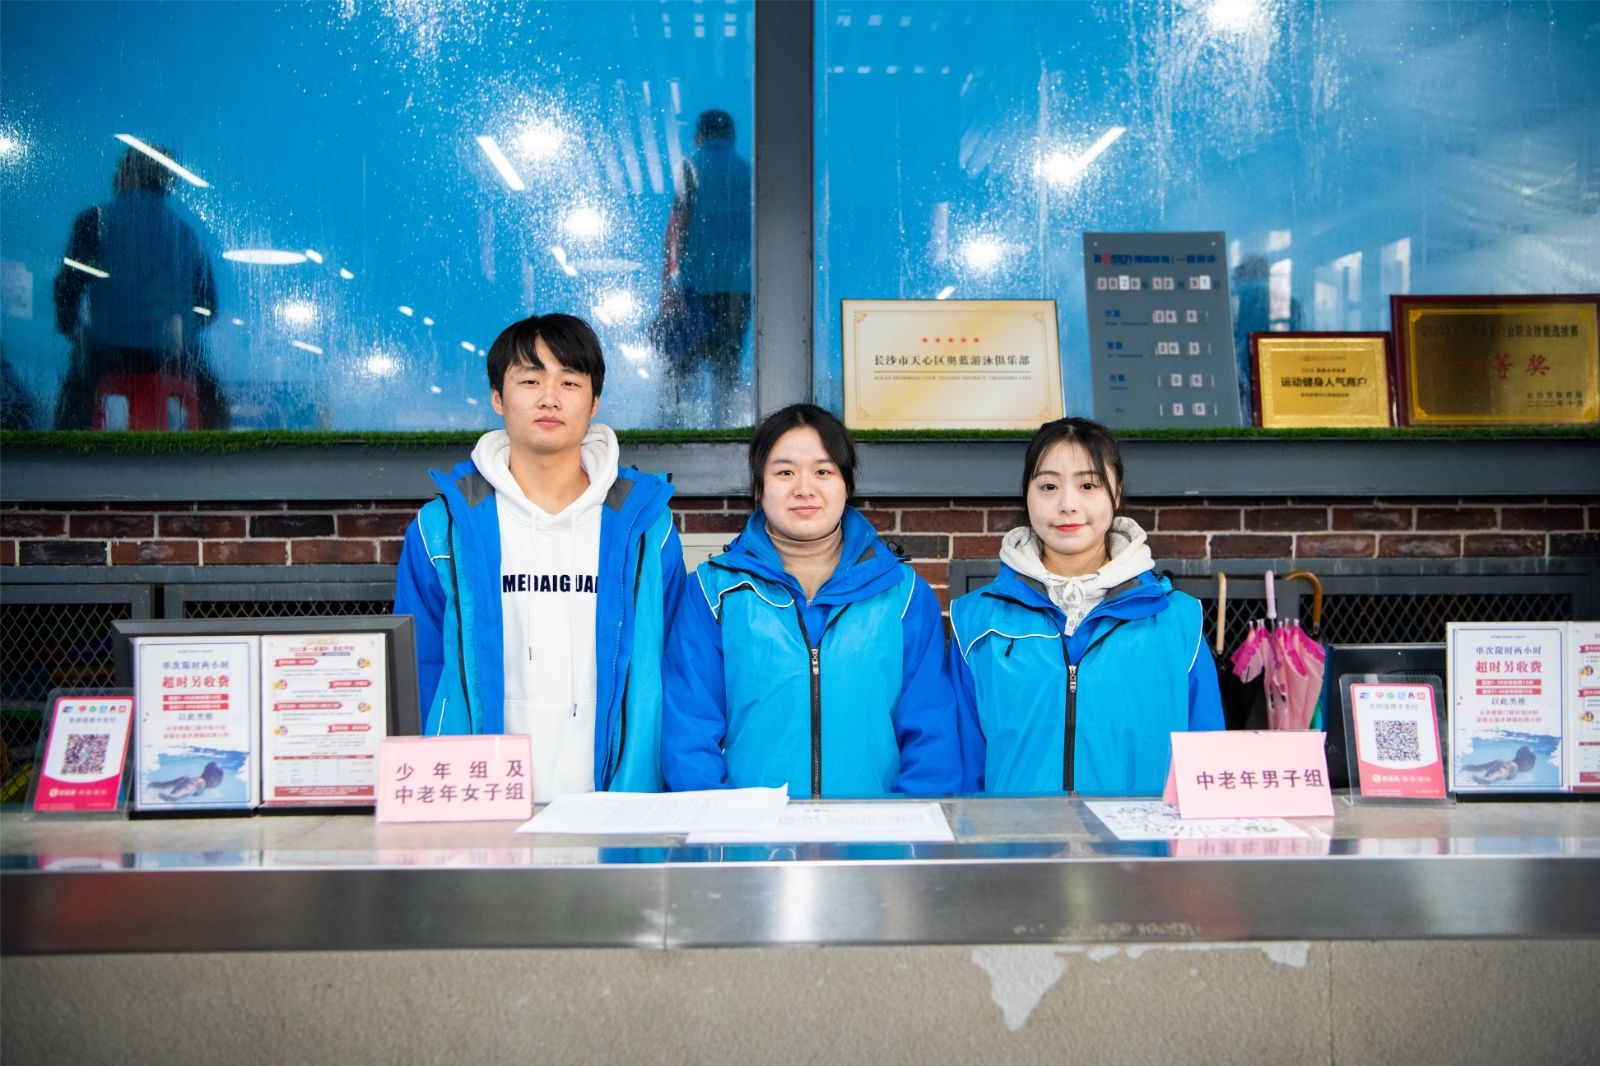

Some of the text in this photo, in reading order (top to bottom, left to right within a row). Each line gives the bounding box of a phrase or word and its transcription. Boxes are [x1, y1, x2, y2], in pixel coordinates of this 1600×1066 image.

[874, 354, 1031, 366] 长沙市天心区奥蓝游泳俱乐部
[1455, 352, 1550, 379] 一等奖
[1281, 377, 1367, 387] 运动健身人气商户
[1475, 661, 1542, 673] 超时另收费
[162, 675, 230, 688] 超时另收费
[396, 760, 524, 782] 少年组及
[1196, 769, 1324, 790] 中老年男子组
[395, 783, 525, 805] 中老年女子组
